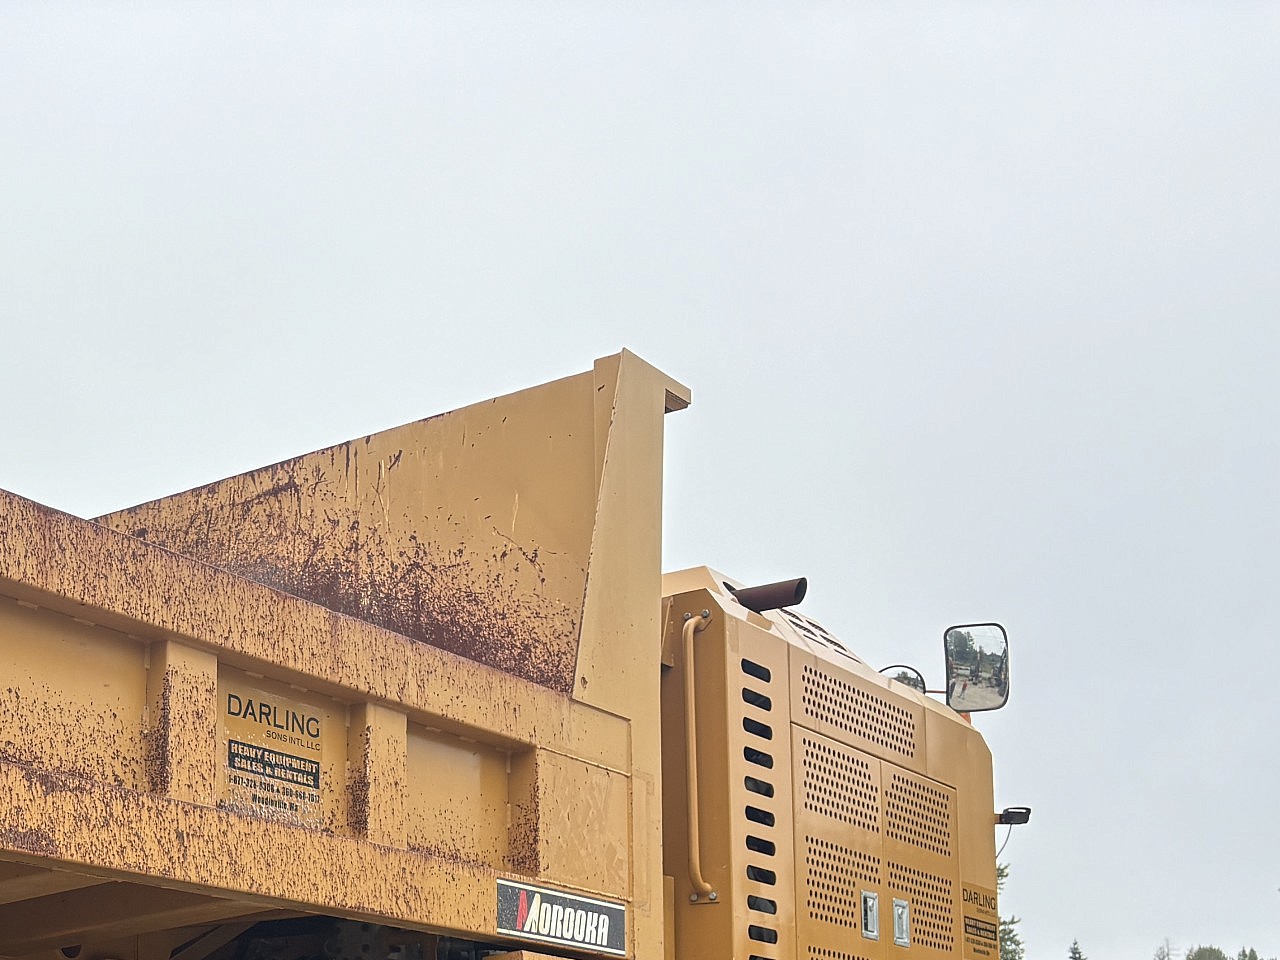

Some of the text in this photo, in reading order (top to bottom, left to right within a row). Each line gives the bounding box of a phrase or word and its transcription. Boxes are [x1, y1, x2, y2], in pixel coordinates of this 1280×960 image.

[227, 693, 320, 738] DARLING
[266, 729, 320, 752] SONS INTL LLC
[231, 743, 318, 773] HEAVY EQUIPMENT
[234, 757, 264, 774] SALES
[274, 768, 314, 786] RENTALS
[962, 888, 996, 910] DARLING
[516, 890, 609, 946] MOROOKA
